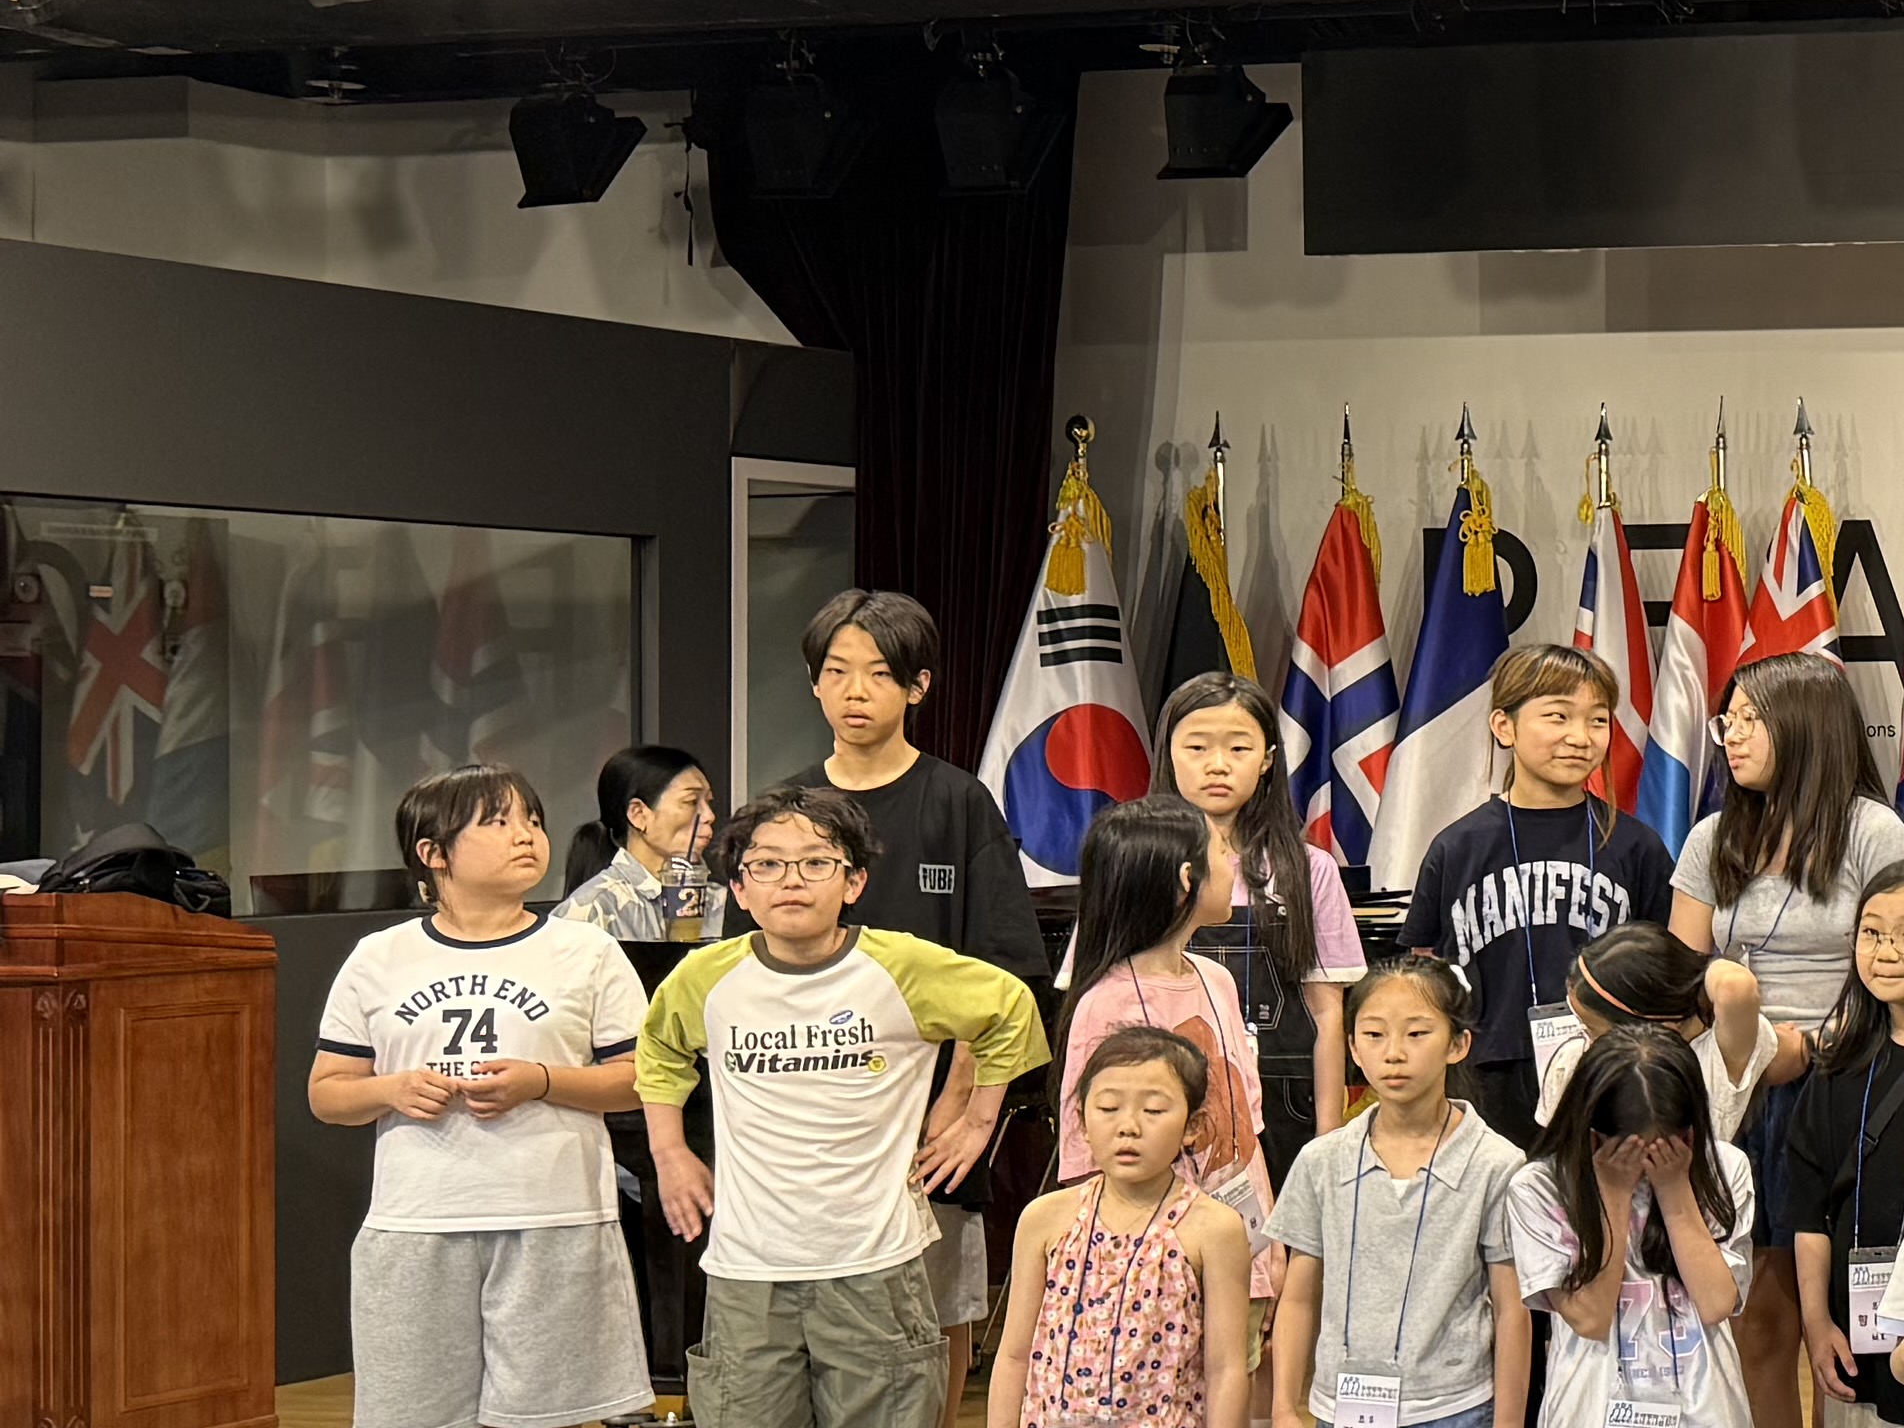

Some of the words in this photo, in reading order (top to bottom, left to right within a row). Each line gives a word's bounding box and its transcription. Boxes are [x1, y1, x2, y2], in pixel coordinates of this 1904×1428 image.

[394, 974, 489, 1026] NORTH
[493, 978, 550, 1022] END
[441, 1007, 498, 1056] 74
[730, 1024, 798, 1051] Local
[805, 1017, 875, 1049] Fresh
[733, 1047, 875, 1075] Vitamins
